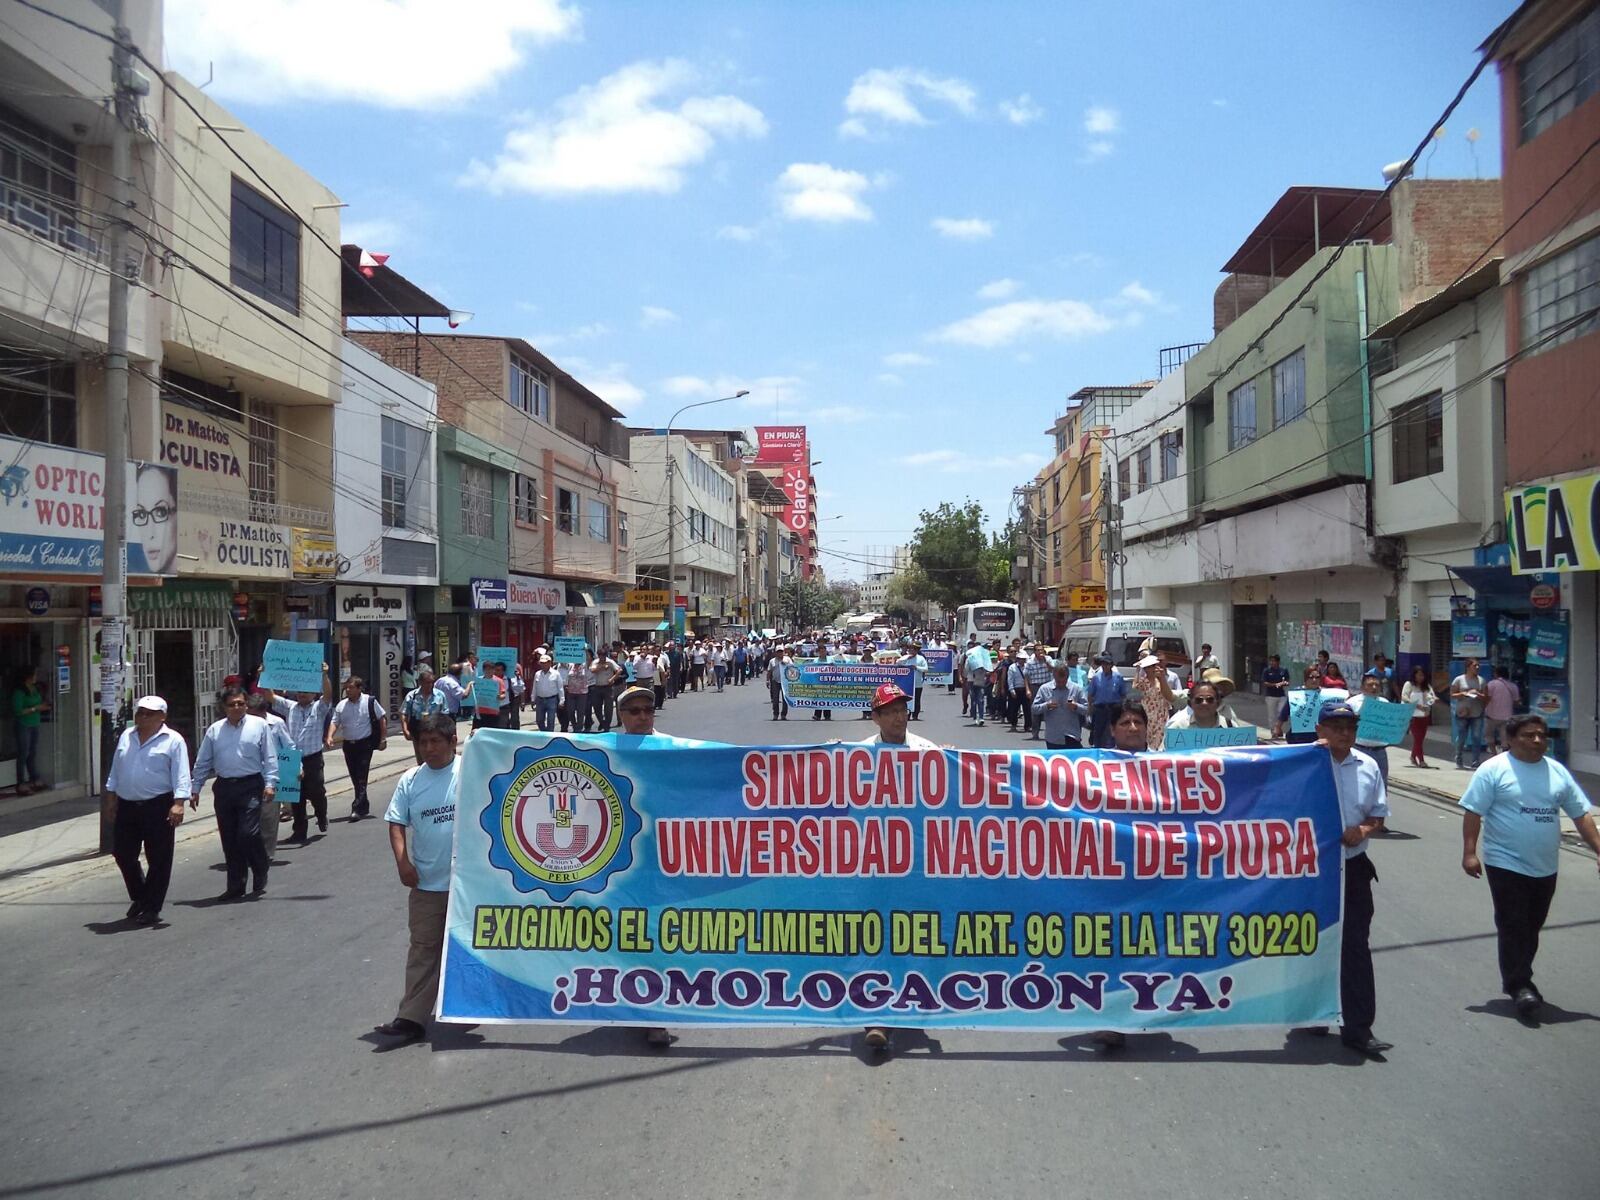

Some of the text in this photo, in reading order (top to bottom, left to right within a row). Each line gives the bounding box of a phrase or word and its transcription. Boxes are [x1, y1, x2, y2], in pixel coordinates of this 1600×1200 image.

[165, 413, 230, 446] Dr. Mattos
[764, 431, 801, 440] EN PIURA
[34, 463, 106, 499] OPTIC
[791, 478, 807, 530] Claro
[220, 521, 283, 544] Dr. Mattos
[1511, 487, 1580, 570] LA
[217, 542, 290, 569] OCULISTA
[28, 600, 48, 609] VISA
[510, 584, 538, 604] Buena
[804, 665, 836, 674] SINDICATO
[846, 666, 878, 675] DOCENTES
[819, 675, 852, 683] ESTAMOS
[385, 651, 400, 721] PROGRESO
[1166, 731, 1187, 749] LA
[504, 759, 622, 828] UNIVERSIDAD NACIONAL DE PIURA
[532, 771, 593, 793] SIDUNP
[743, 749, 1226, 814] SINDICATO DE DOCENTES
[656, 815, 1320, 879] UNIVERSIDAD NACIONAL DE PIURA
[548, 872, 579, 881] PERU
[473, 905, 1320, 957] EXIGIMOS EL CUMPLIMIENTO DEL ART. 96 DE LA LEY 30220
[551, 961, 1235, 1016] ¡HOMOLOGACIÓN YA!
